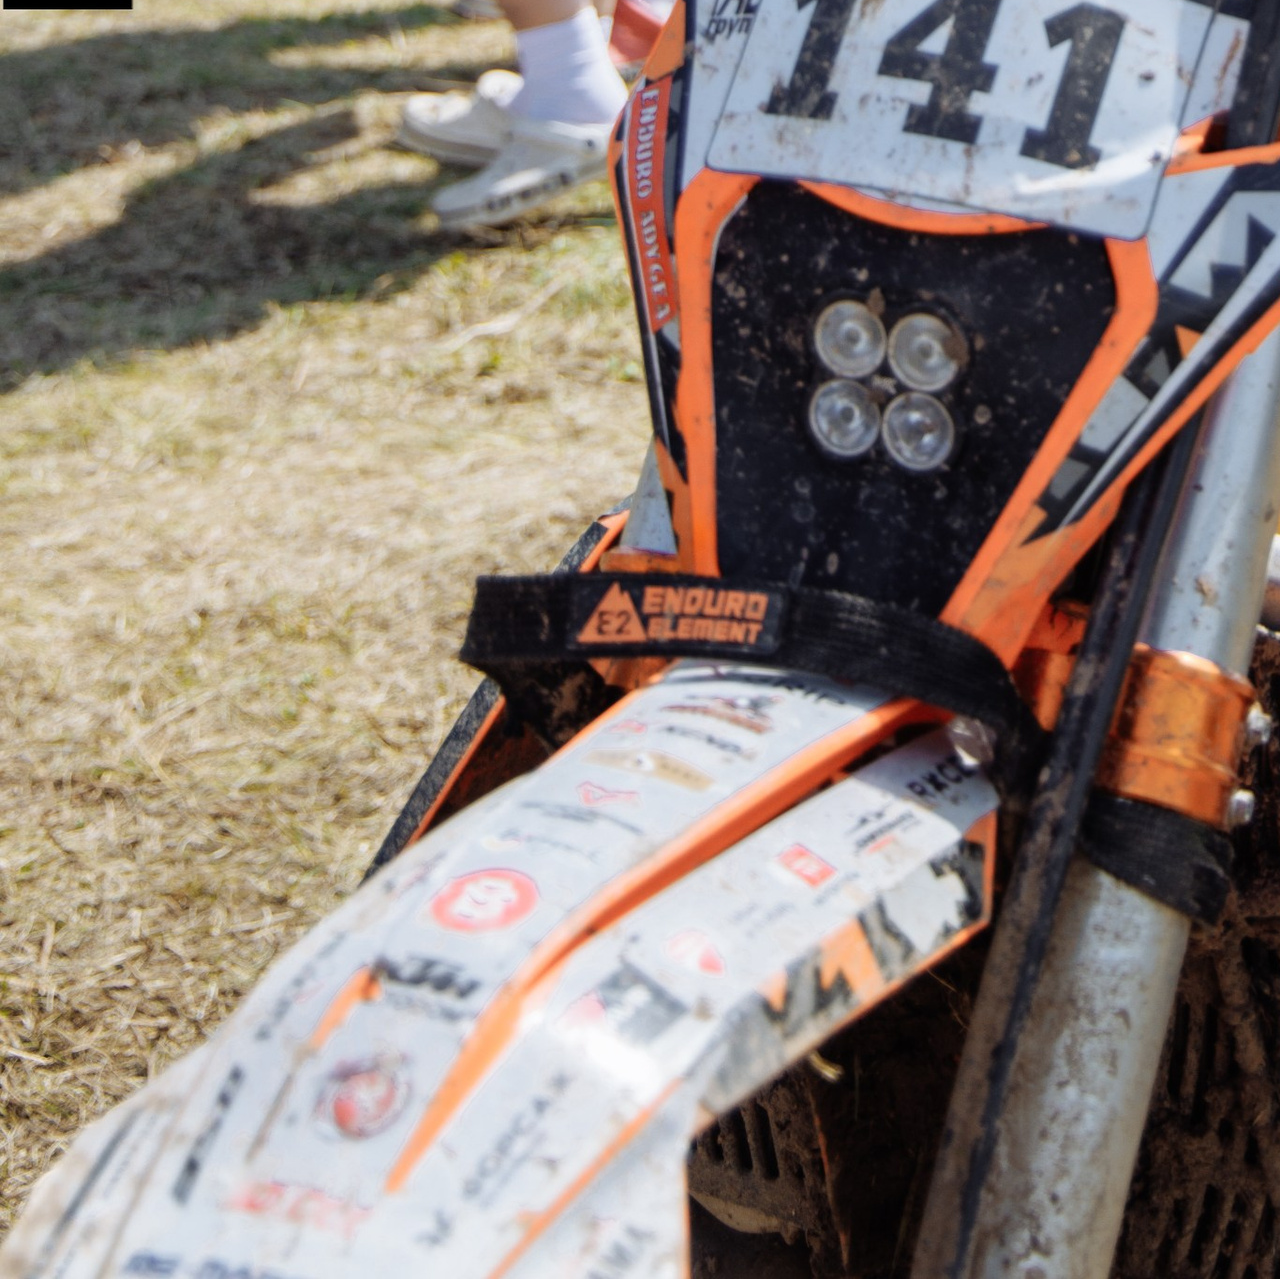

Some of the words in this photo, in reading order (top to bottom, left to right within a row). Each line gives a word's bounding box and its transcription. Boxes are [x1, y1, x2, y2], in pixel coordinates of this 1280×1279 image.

[704, 17, 752, 44] груп
[635, 88, 659, 198] ENDURO
[642, 585, 769, 622] ENDURO
[647, 615, 763, 645] ELEMENT
